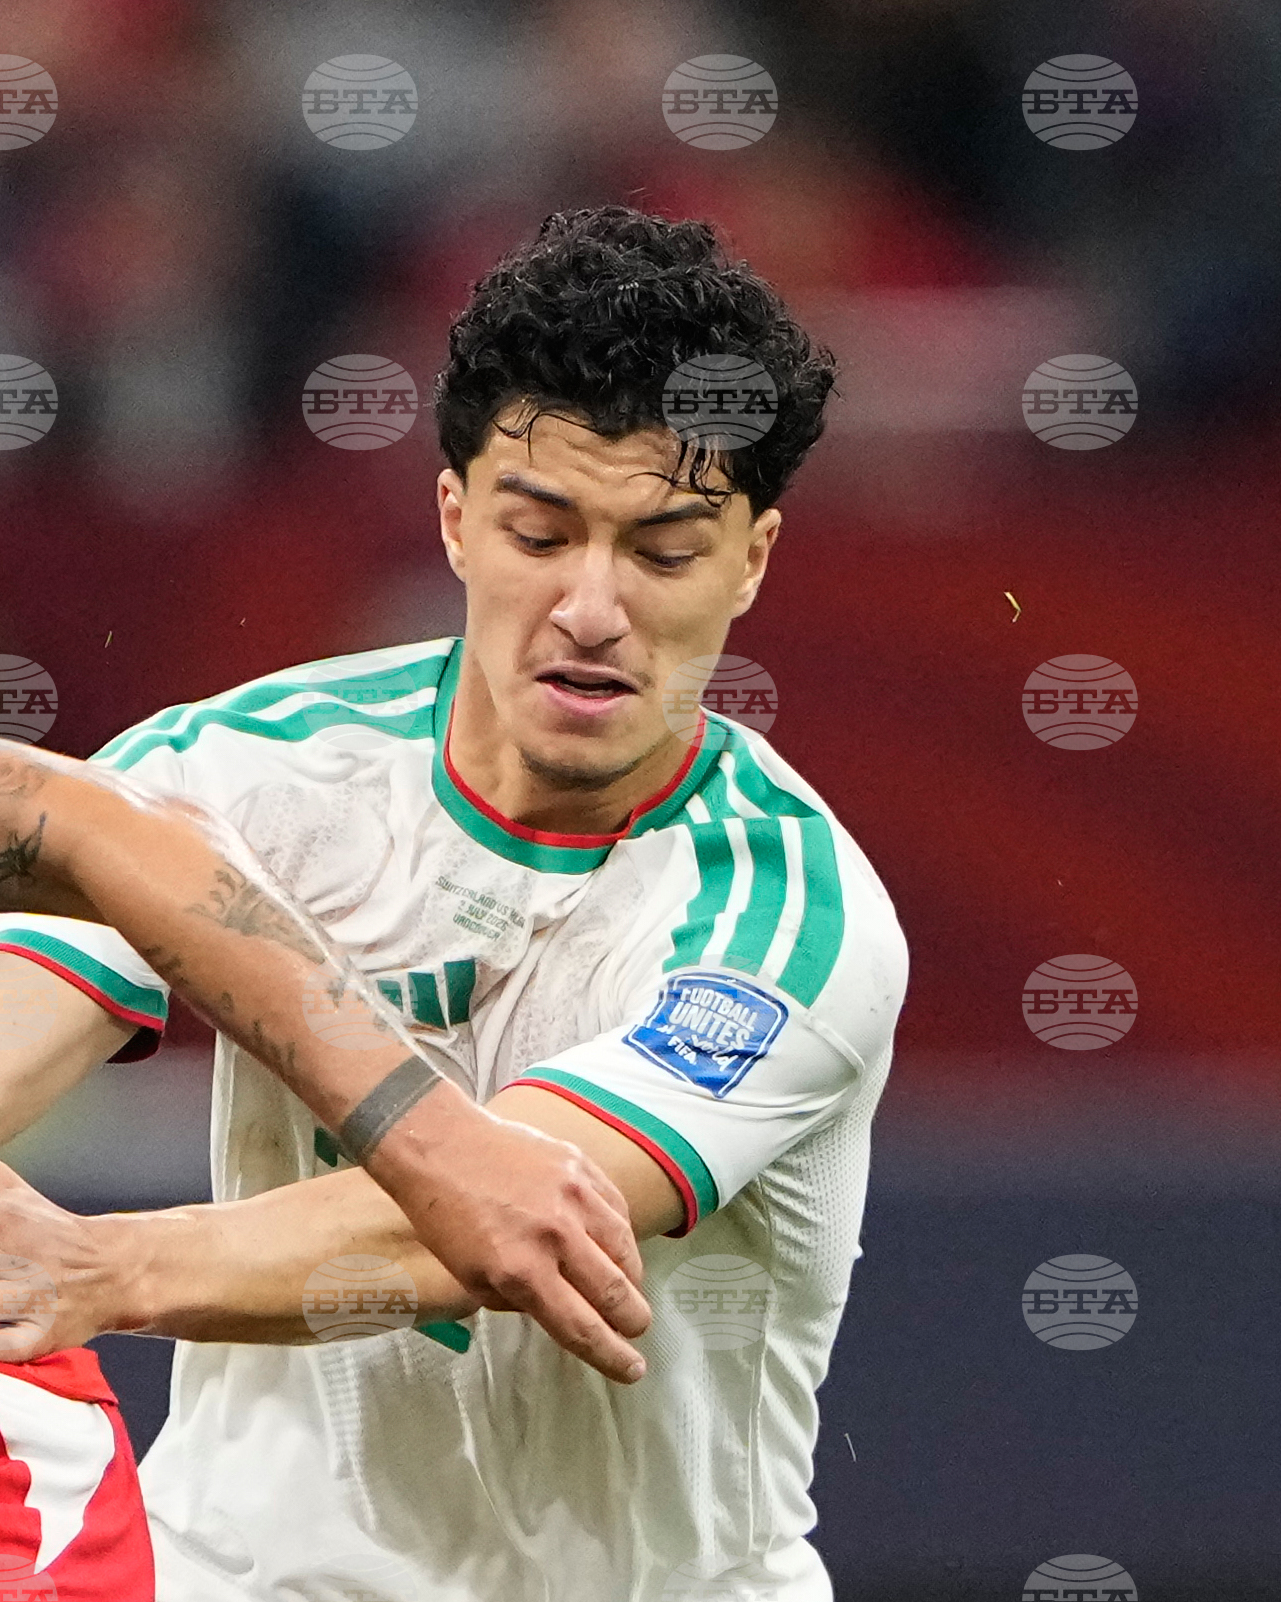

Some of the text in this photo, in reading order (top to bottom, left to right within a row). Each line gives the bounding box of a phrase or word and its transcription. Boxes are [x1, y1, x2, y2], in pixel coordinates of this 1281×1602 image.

[435, 875, 497, 910] SWITZERLAND
[486, 914, 509, 932] 2026
[669, 1002, 751, 1050] UNITES
[667, 1035, 698, 1066] FIFA
